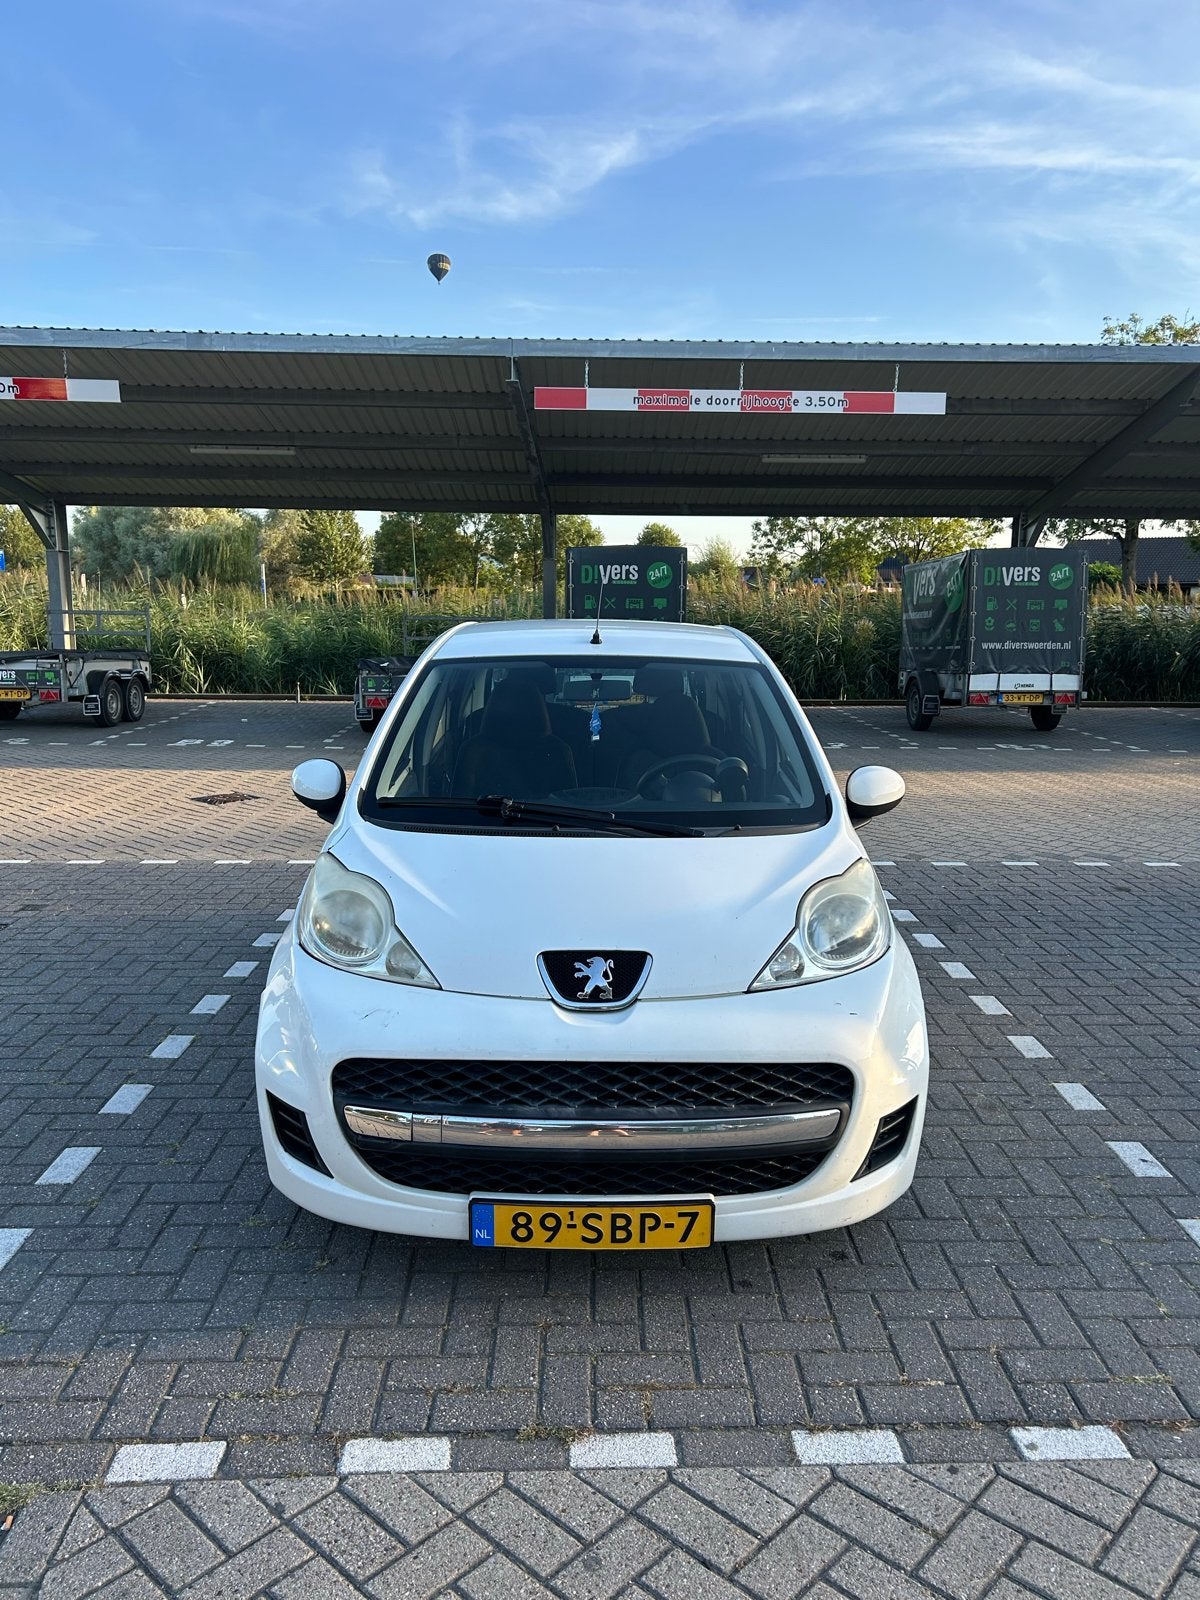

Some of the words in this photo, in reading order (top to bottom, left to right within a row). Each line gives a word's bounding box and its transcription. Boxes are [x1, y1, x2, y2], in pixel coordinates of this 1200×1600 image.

[633, 394, 701, 405] maximale
[706, 395, 800, 409] doorrijhoogte
[805, 397, 848, 407] 3.50m
[981, 640, 1072, 650] www.diverswoerden.nl
[1004, 694, 1041, 702] 33-WT-DP
[475, 1229, 491, 1239] NL
